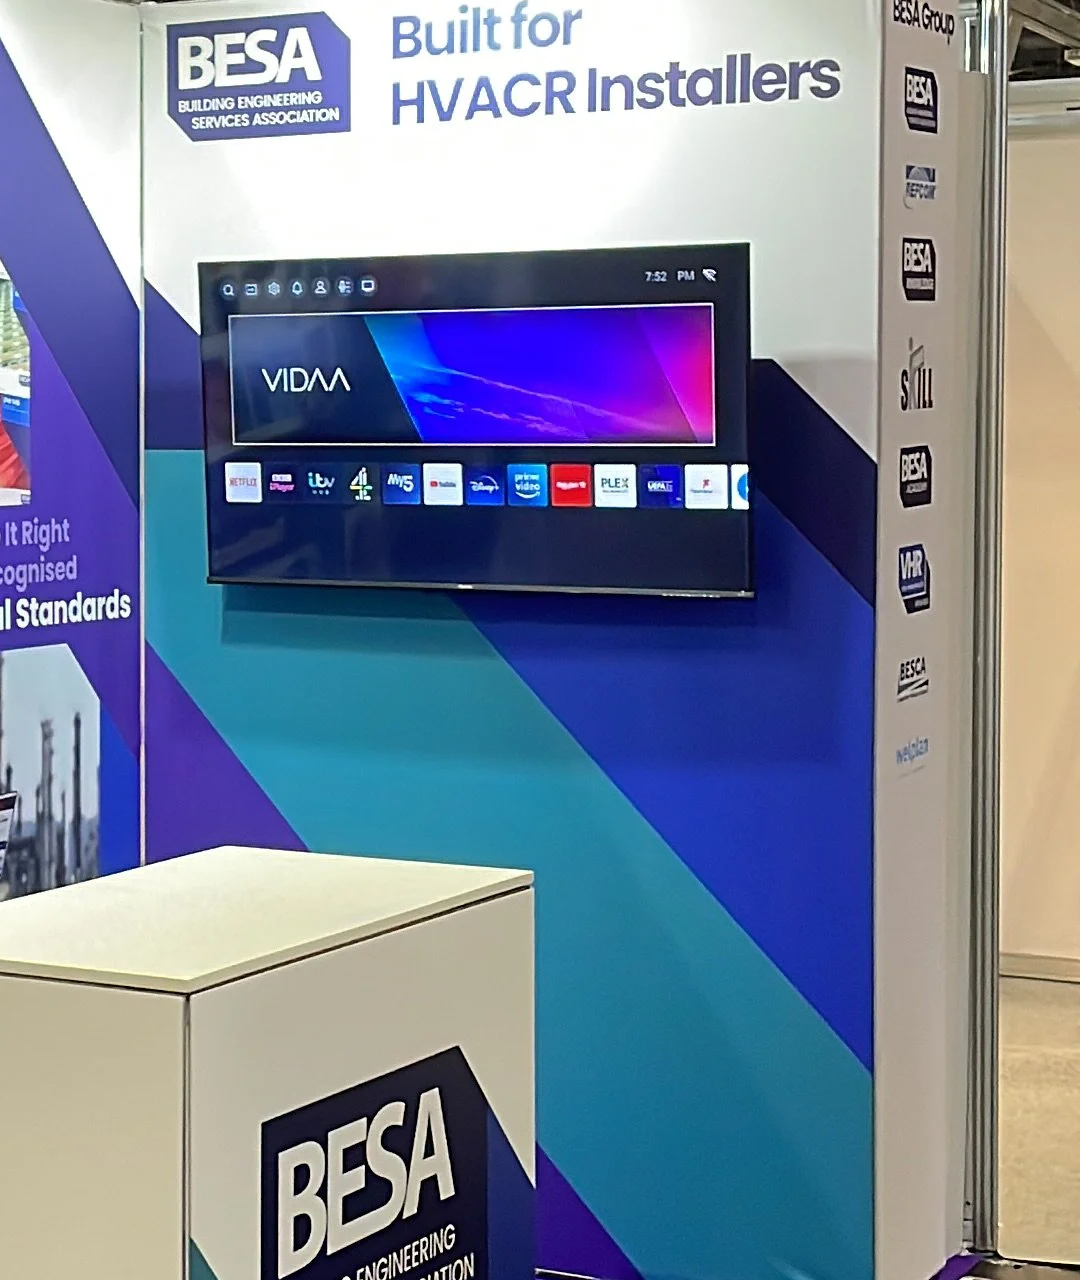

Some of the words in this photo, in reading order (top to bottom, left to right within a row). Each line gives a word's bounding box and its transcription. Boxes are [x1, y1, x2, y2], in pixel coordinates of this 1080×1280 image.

[392, 3, 503, 59] Built
[511, 0, 583, 49] for
[922, 2, 955, 46] Group
[178, 26, 322, 90] BESA
[178, 97, 235, 113] BUILDING
[237, 91, 322, 109] ENGINEERING
[392, 70, 576, 126] HVACR
[588, 53, 841, 112] Installers
[906, 74, 933, 106] BESA
[191, 114, 249, 129] SERVICES
[252, 108, 339, 126] ASSOCIATION
[903, 242, 931, 272] BESA
[645, 271, 667, 282] 7:52
[677, 270, 695, 281] PM
[387, 473, 414, 493] My5
[902, 453, 927, 482] BESA
[601, 478, 629, 489] PLEX
[5, 521, 18, 546] It
[22, 517, 70, 552] Right
[15, 589, 131, 629] Standards
[900, 657, 926, 681] BESCA
[277, 1086, 456, 1280] BESA
